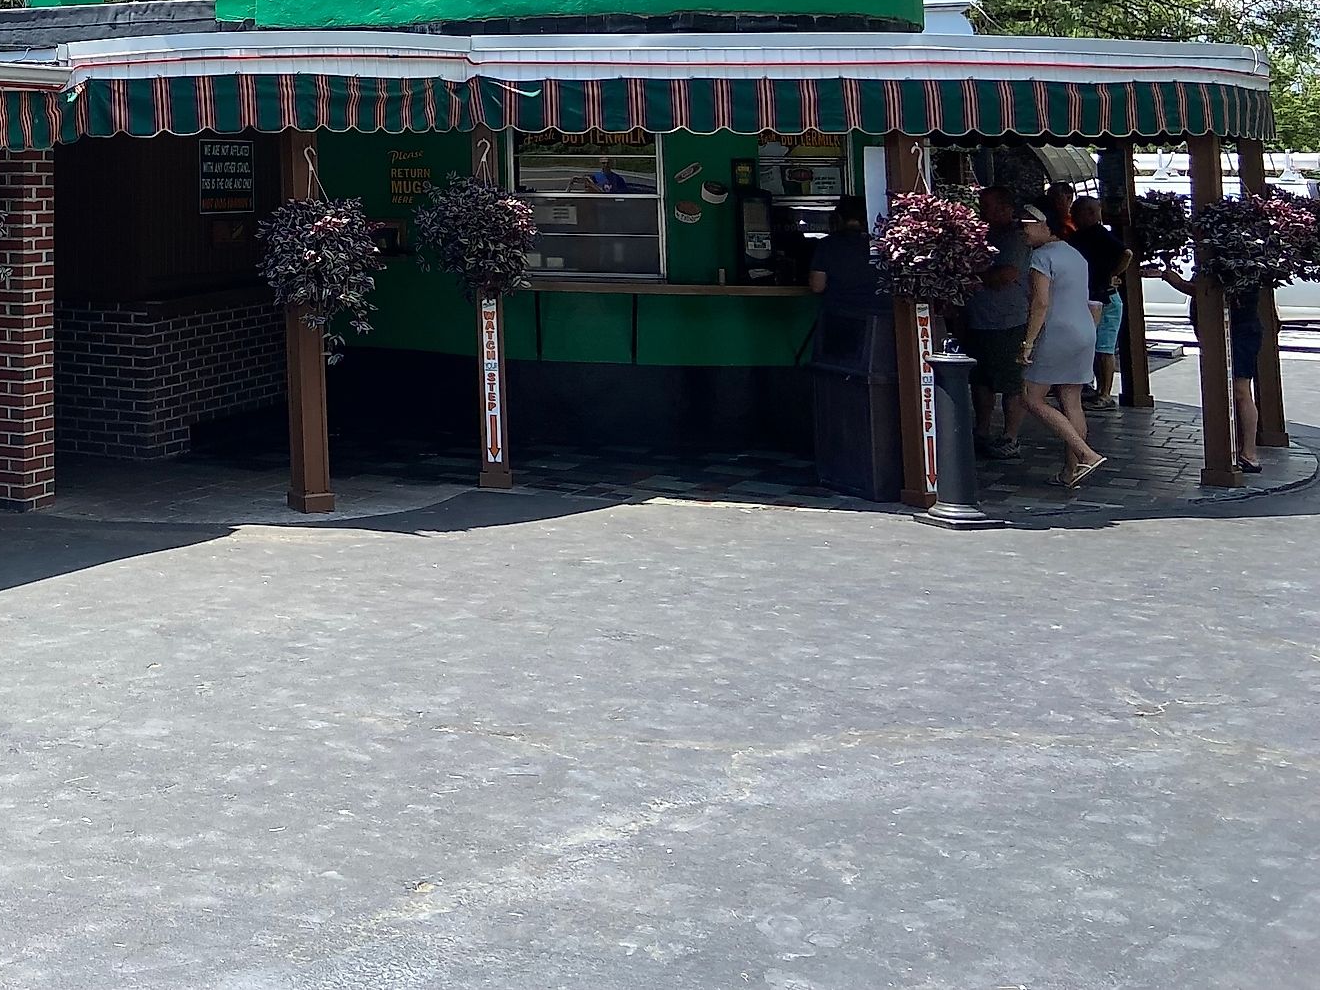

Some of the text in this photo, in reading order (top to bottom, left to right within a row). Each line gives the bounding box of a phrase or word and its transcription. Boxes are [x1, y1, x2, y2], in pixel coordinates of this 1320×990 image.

[391, 168, 431, 178] RETURN
[391, 180, 426, 194] MUG
[391, 195, 415, 204] HERE
[484, 311, 495, 360] WATCH
[487, 372, 497, 412] STEP
[924, 387, 932, 432] STEP
